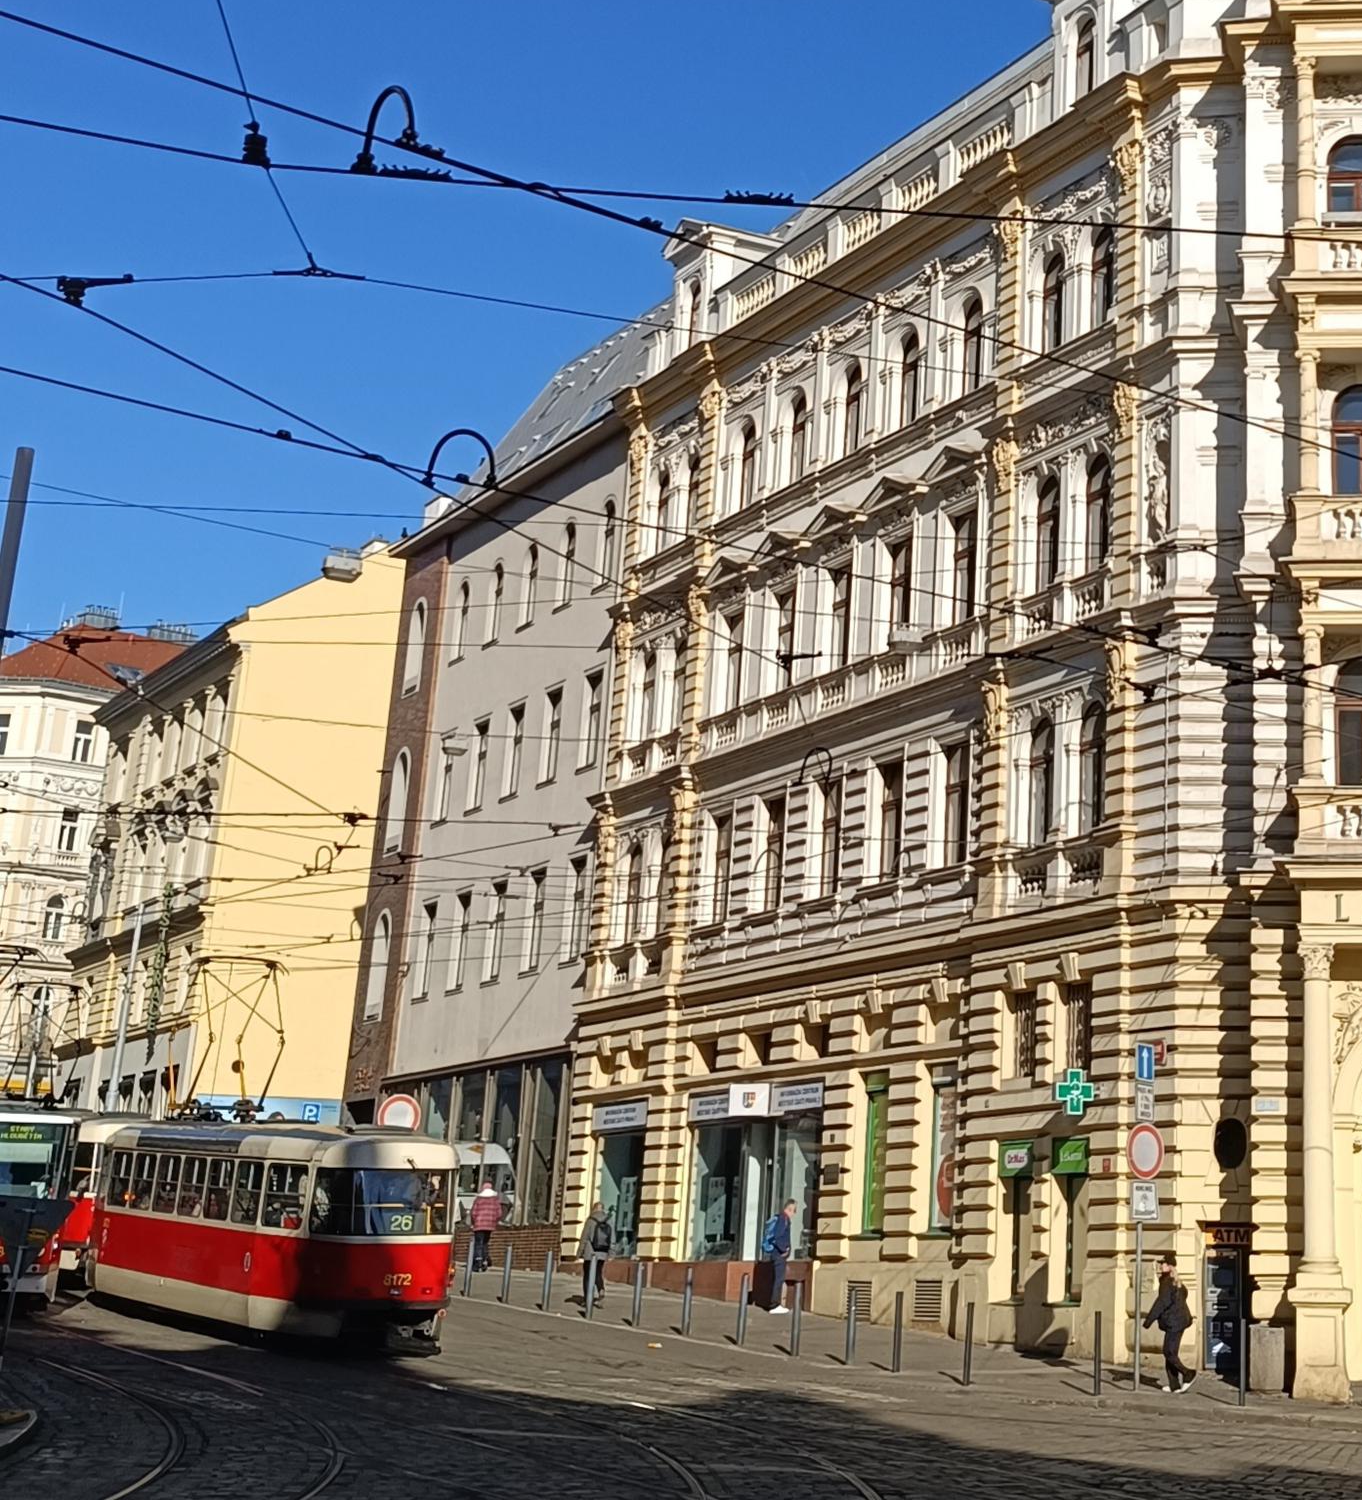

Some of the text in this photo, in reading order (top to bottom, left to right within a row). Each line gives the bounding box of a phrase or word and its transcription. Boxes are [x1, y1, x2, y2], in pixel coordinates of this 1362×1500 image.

[390, 1214, 413, 1231] 26
[1214, 1229, 1250, 1243] ATM
[383, 1273, 412, 1286] 8172
